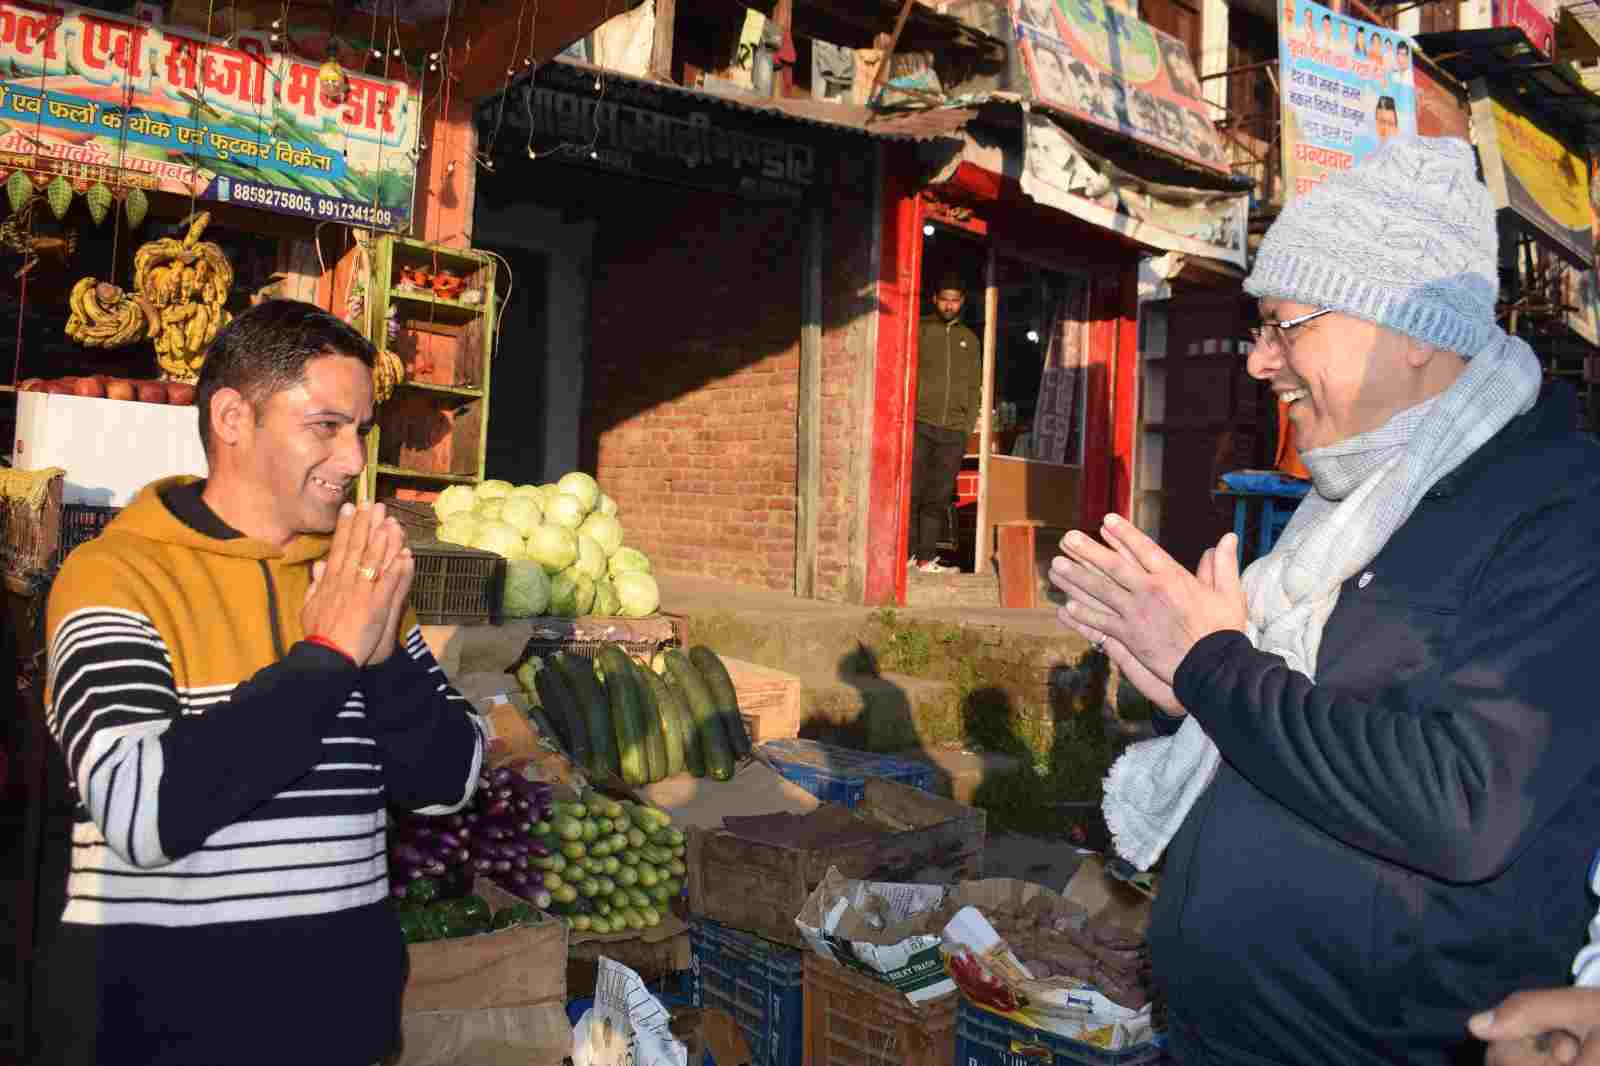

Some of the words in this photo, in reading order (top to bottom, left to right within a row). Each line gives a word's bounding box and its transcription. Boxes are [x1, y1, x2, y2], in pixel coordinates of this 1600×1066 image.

[48, 100, 99, 124] फलों
[176, 125, 209, 145] एवं
[210, 133, 271, 160] फुटकर
[275, 141, 332, 171] विक्रेता
[1295, 144, 1353, 170] धन्यवाद
[233, 183, 315, 215] 8859275805,
